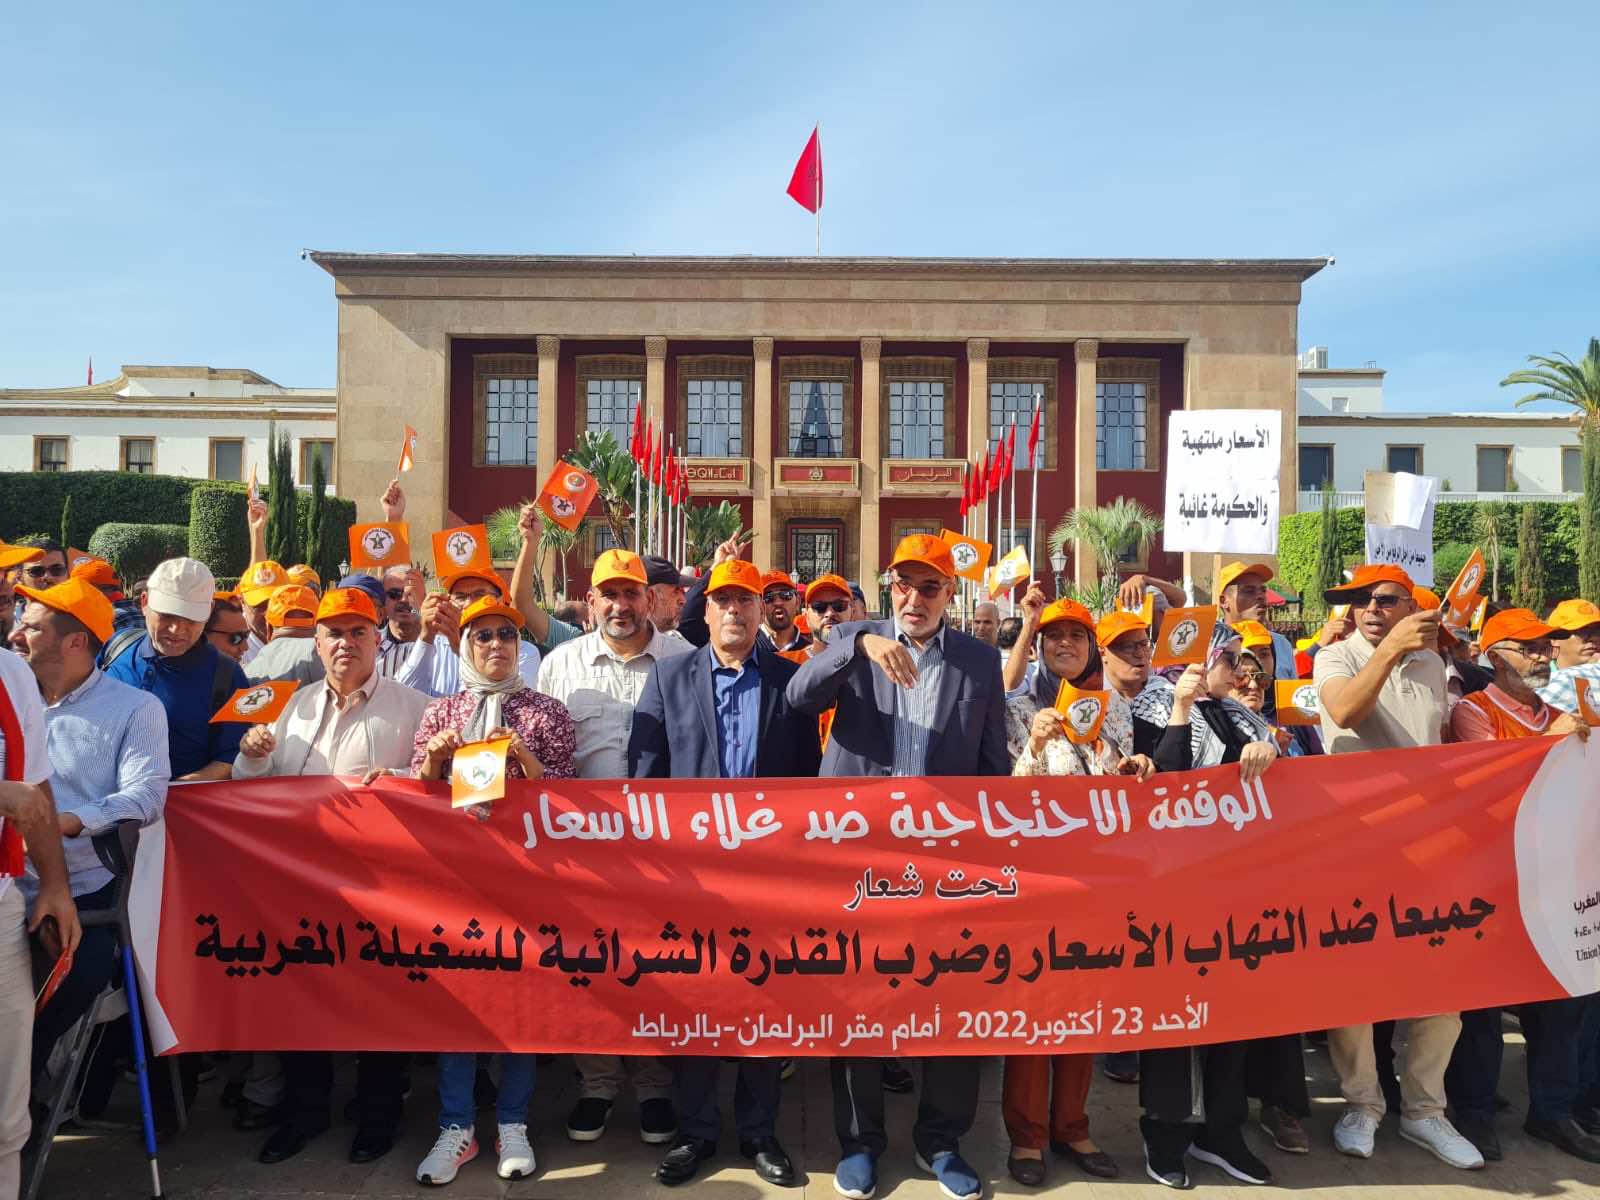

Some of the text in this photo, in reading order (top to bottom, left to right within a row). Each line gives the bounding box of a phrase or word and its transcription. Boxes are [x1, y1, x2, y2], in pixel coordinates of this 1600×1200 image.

[1182, 424, 1270, 456] الأسعار ملتهبة
[1179, 493, 1268, 527] والحكومة غائبة
[523, 776, 1273, 850] الوقفة الاحتجاجية ضد غلاء الأسعار
[842, 862, 1019, 911] تحت شعار
[194, 893, 1496, 988] جميعا ضد التهاب الأسعار وضرب القدرة الشرائية للشغيلة المغربية
[1576, 947, 1597, 962] Union
[840, 1013, 884, 1050] مقر
[892, 1003, 942, 1051] أمام
[1111, 1008, 1143, 1036] 23
[1152, 995, 1209, 1033] الأحد
